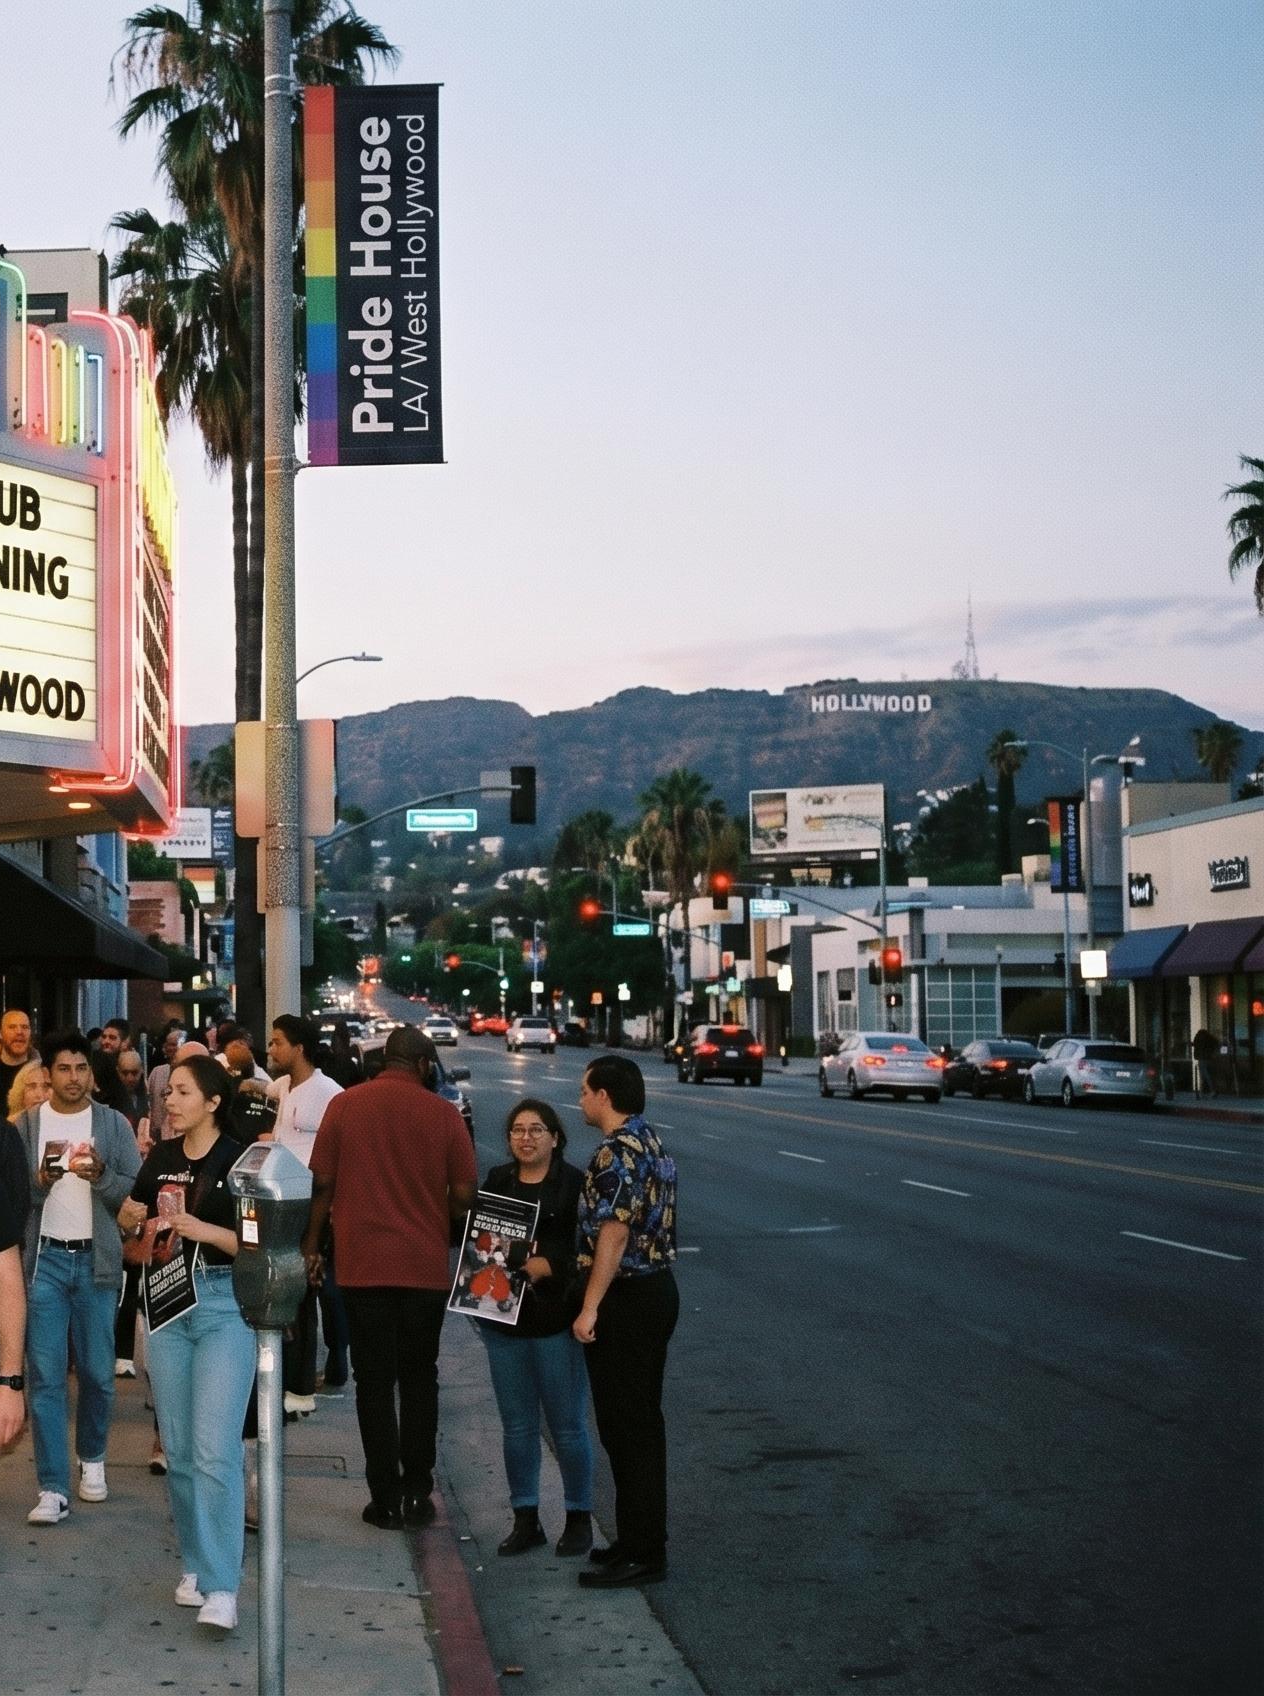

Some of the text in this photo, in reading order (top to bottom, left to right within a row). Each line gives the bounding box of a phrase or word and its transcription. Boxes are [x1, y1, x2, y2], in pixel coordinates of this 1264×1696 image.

[397, 114, 434, 278] Hollywood
[348, 116, 394, 434] Pride House
[400, 290, 428, 368] West
[811, 694, 932, 713] HOLLYWOOD
